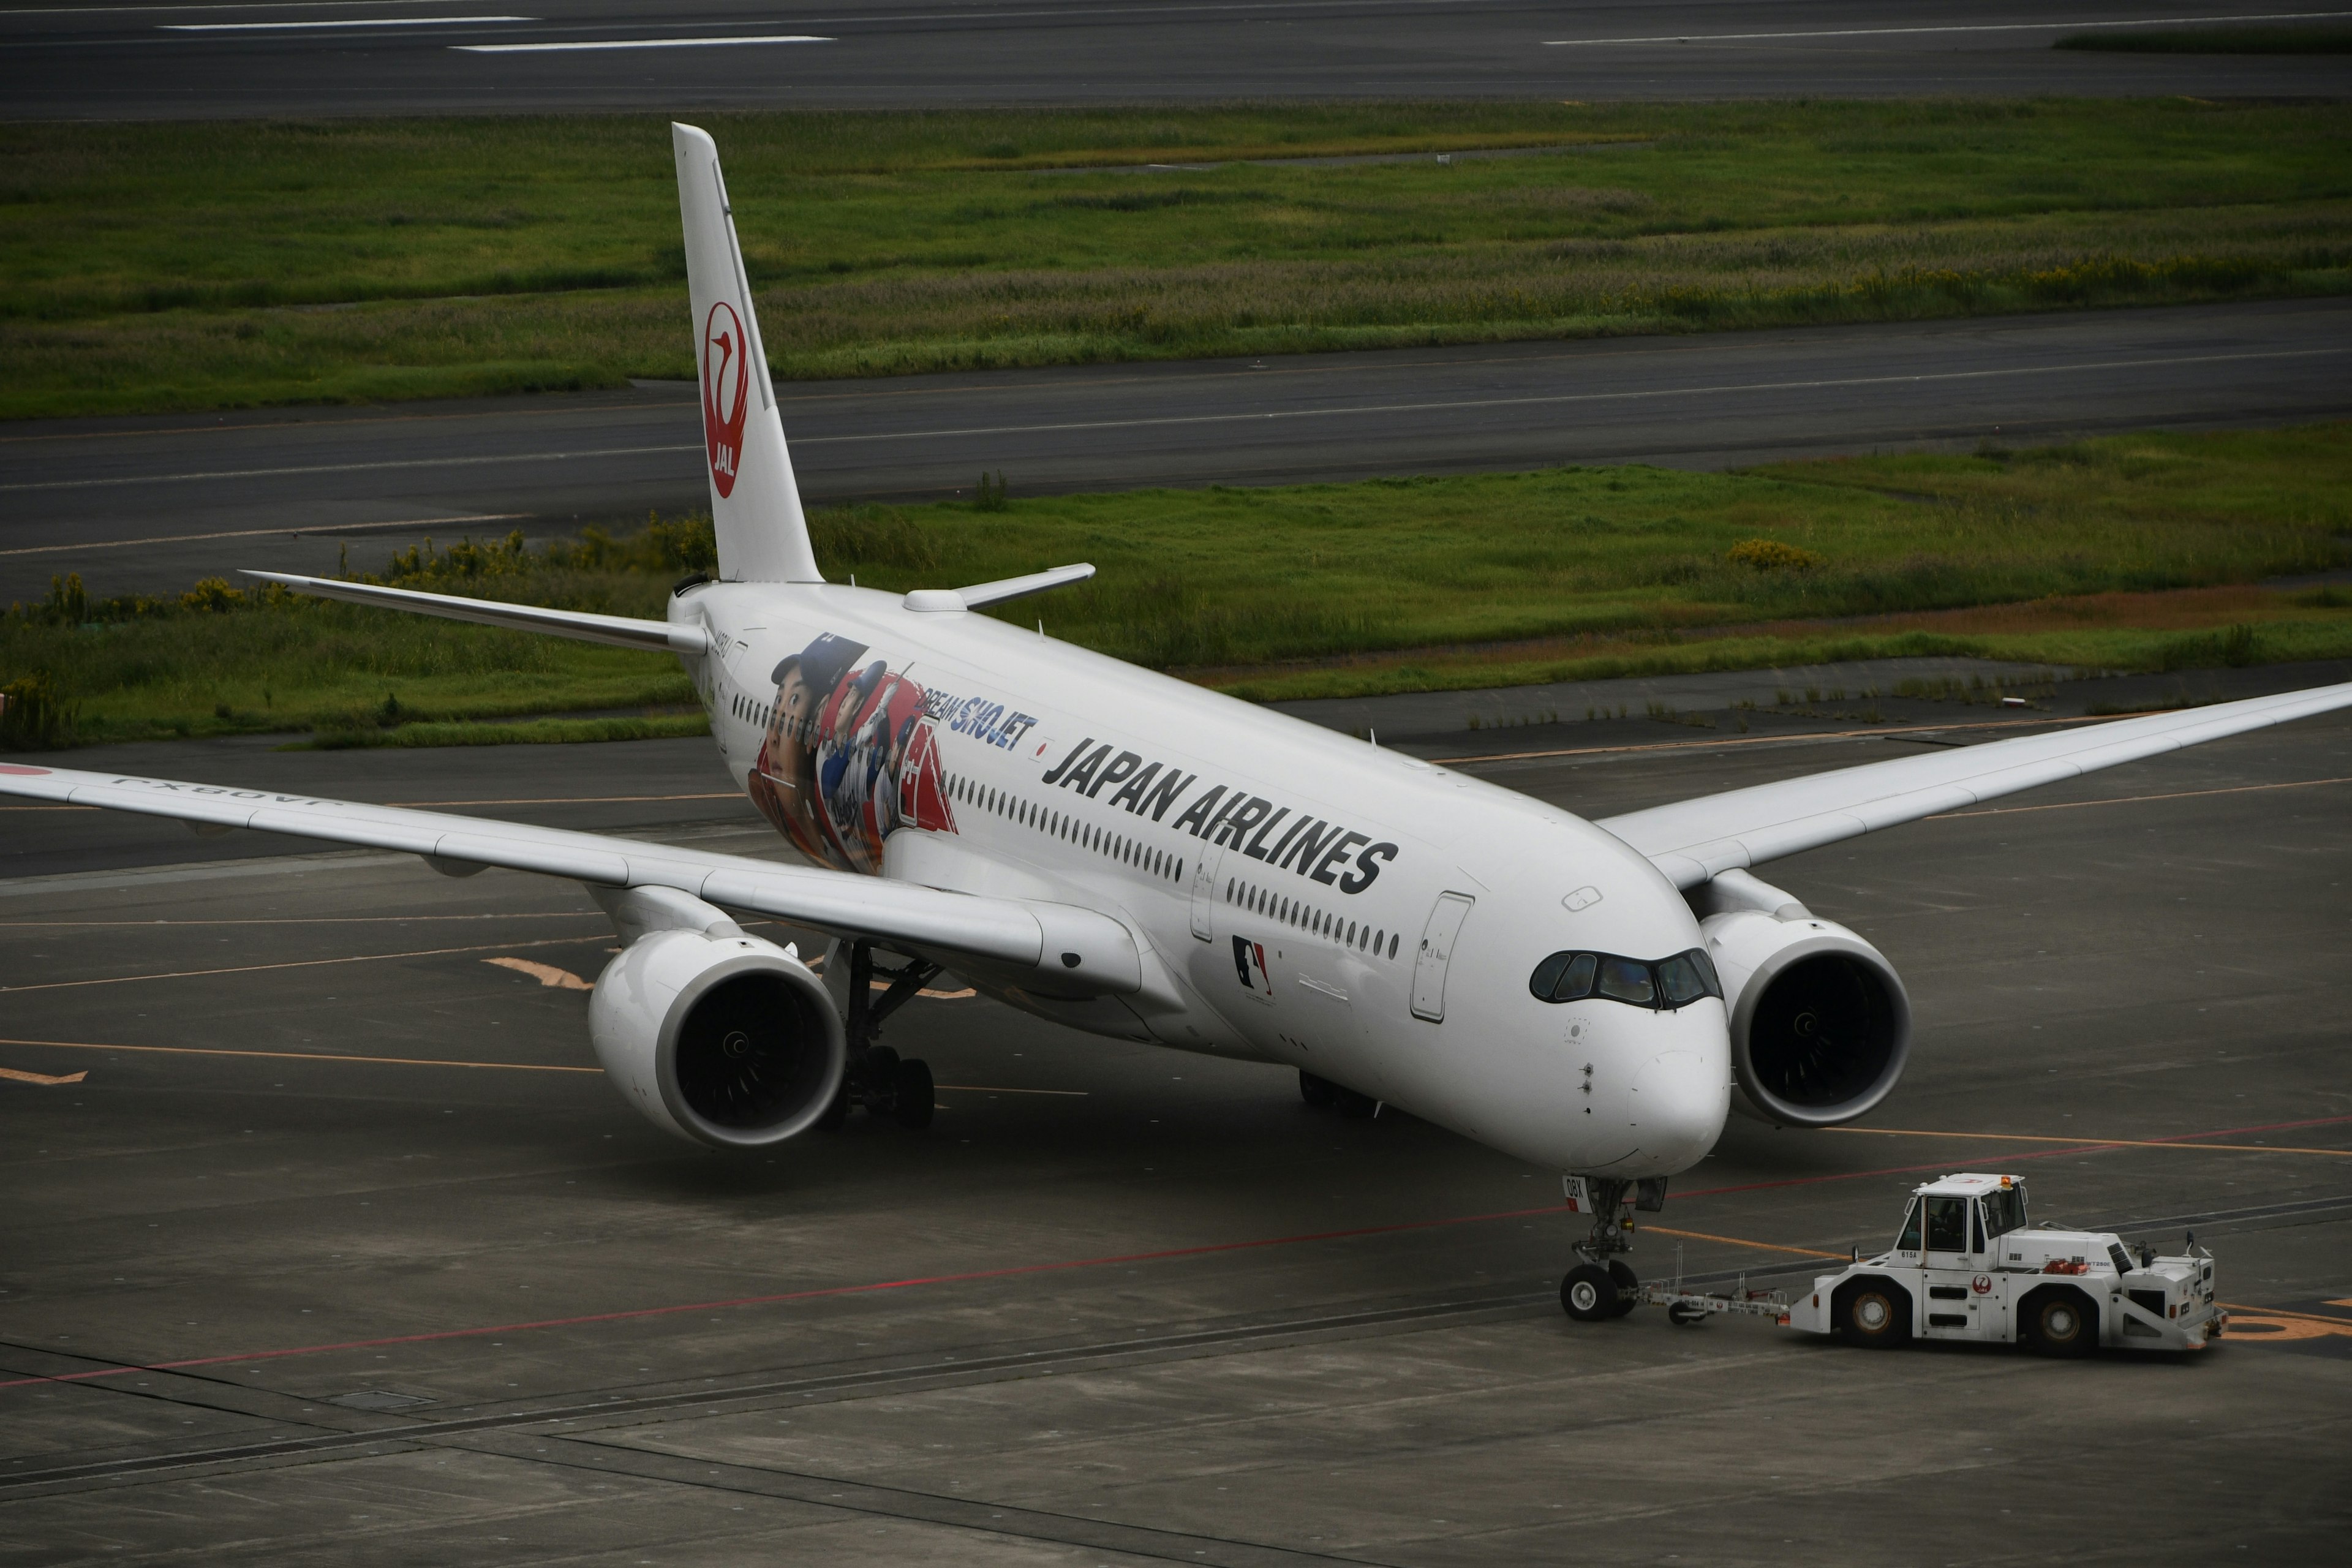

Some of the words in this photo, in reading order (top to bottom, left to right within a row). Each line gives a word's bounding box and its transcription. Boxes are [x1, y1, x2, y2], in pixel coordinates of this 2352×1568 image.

[715, 442, 735, 477] JAL
[914, 687, 965, 722] DREAM
[112, 778, 344, 806] JA08XJ
[1042, 737, 1197, 822] JAPAN
[1172, 785, 1399, 894] AIRLINES
[1567, 1178, 1583, 1198] 08X
